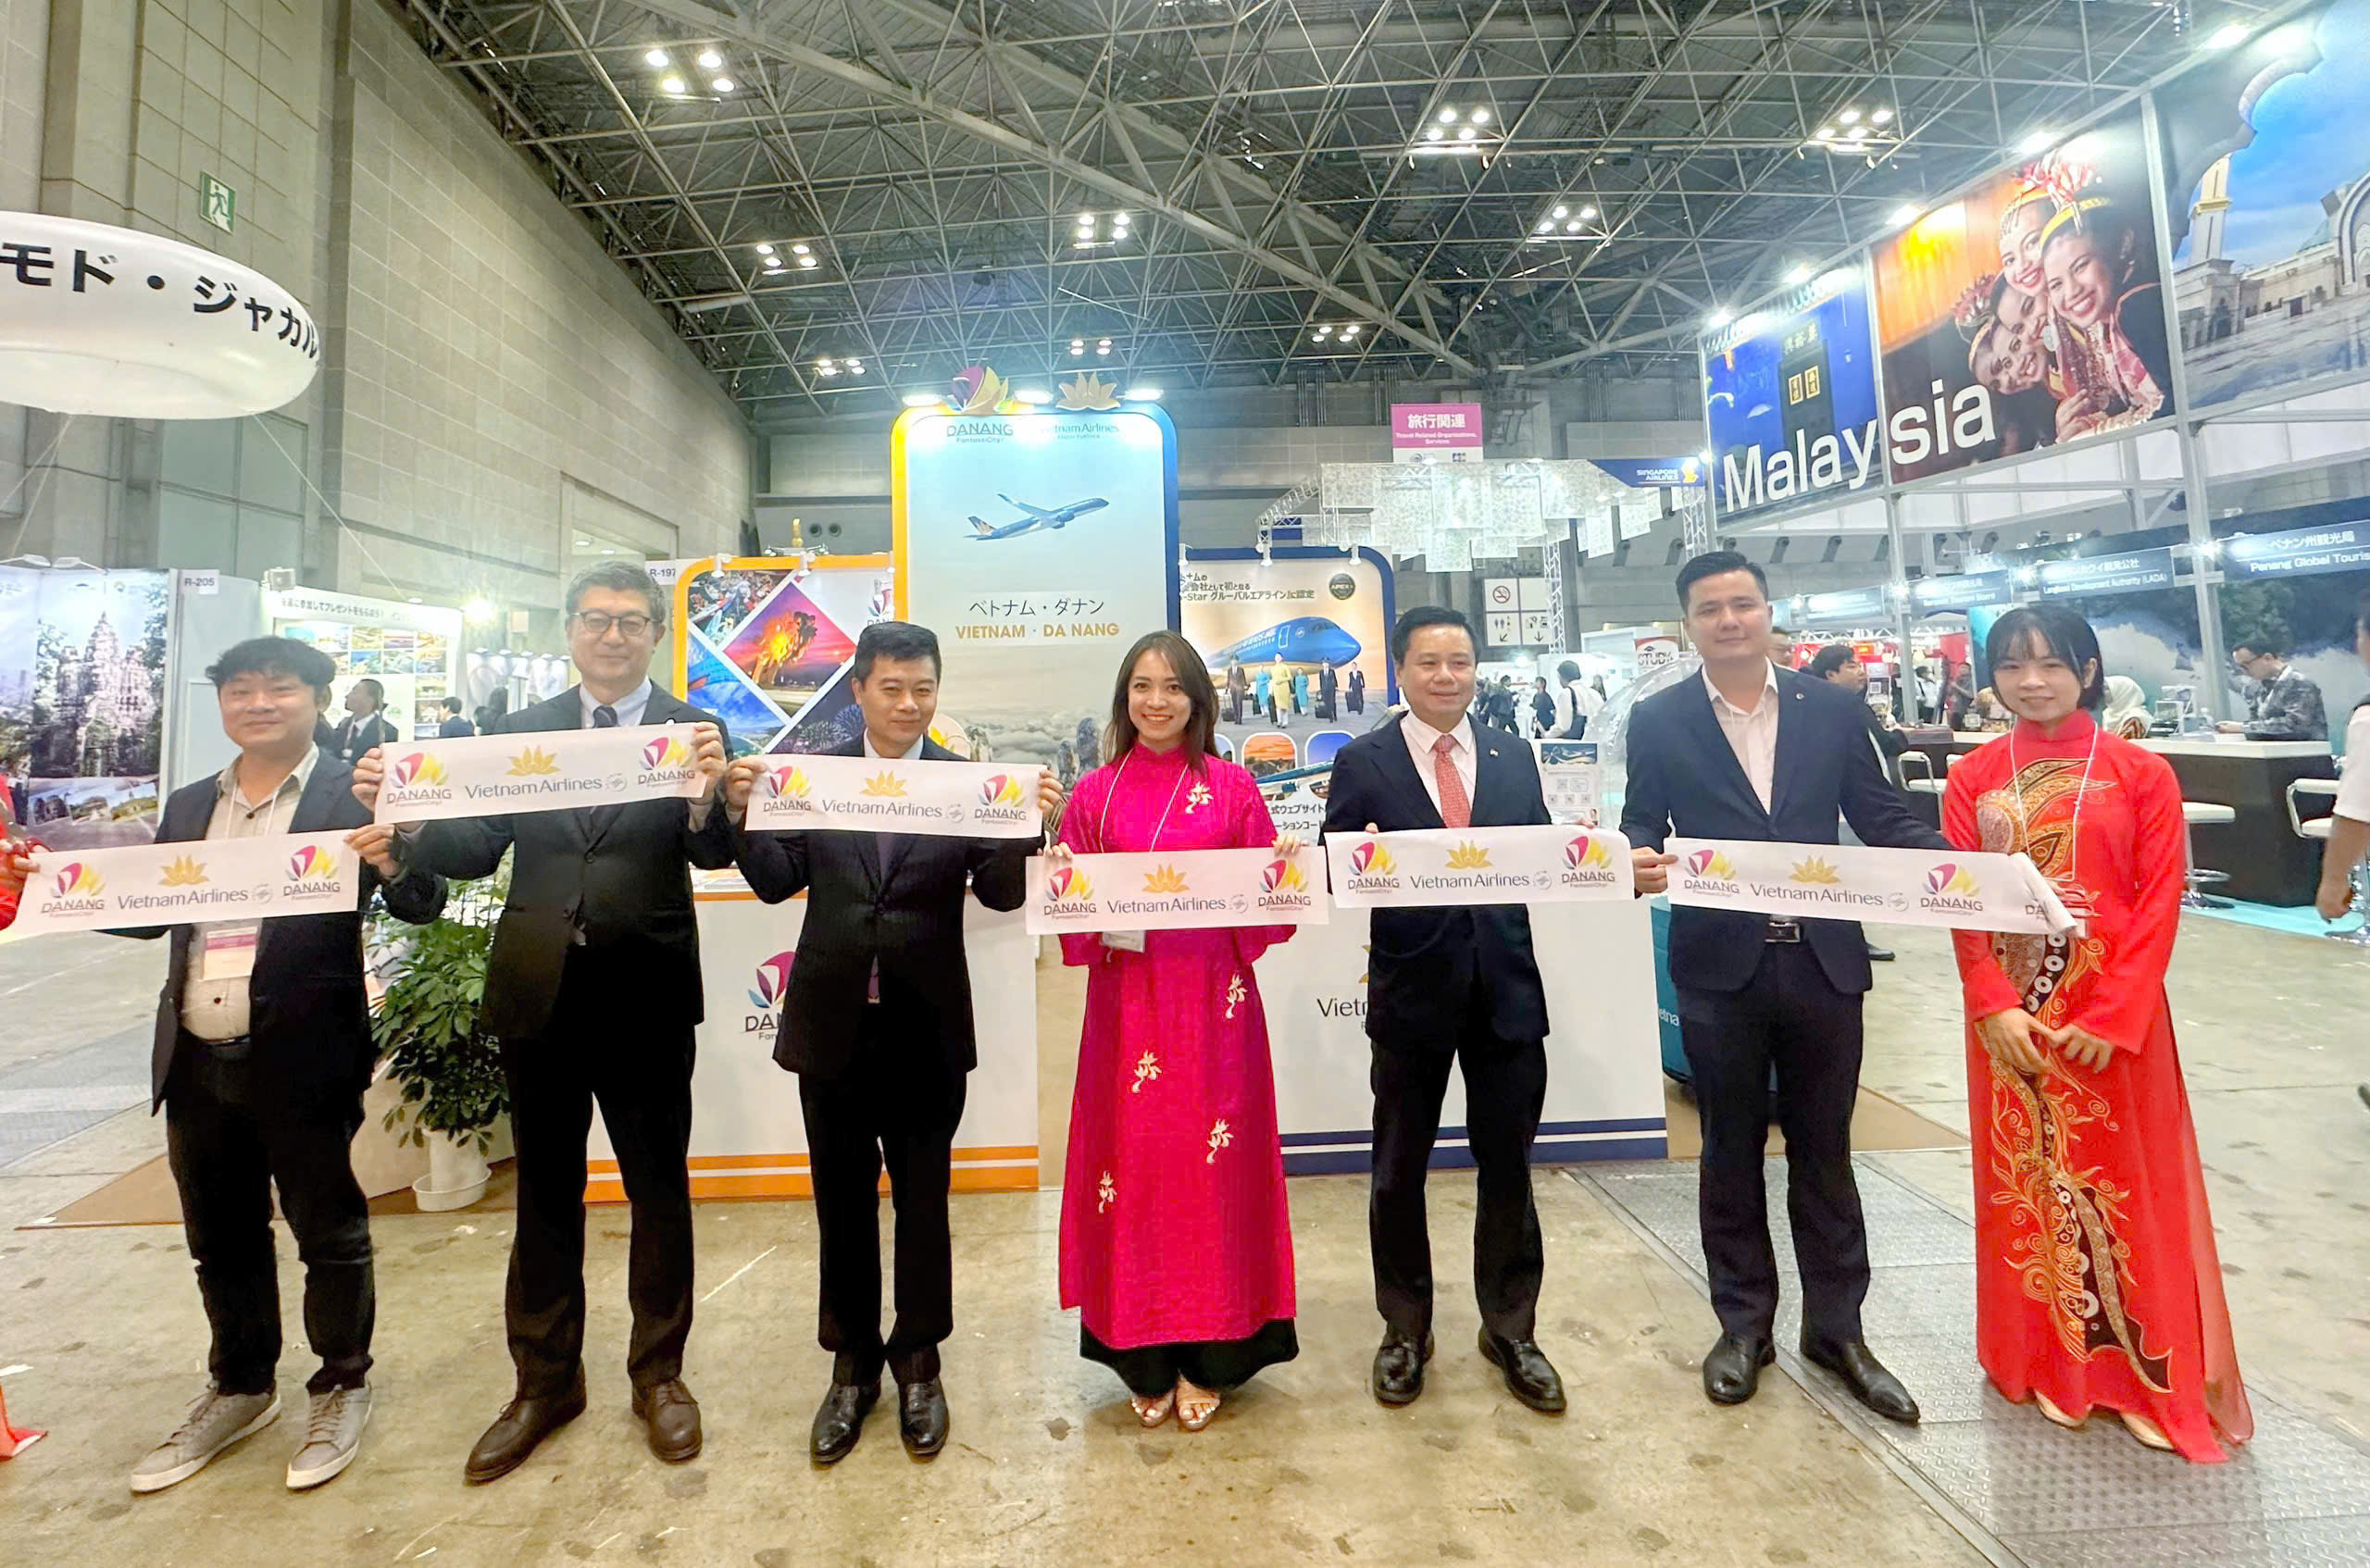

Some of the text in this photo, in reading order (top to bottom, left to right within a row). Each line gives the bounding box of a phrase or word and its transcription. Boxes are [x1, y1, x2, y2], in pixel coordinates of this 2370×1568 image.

[1408, 414, 1466, 429] 旅行関連
[946, 422, 1014, 437] DANANG
[1723, 379, 1996, 512] Malaysia
[2250, 561, 2292, 572] Penang
[2294, 555, 2329, 567] Global
[185, 578, 215, 586] R-205
[1180, 592, 1207, 601] -Star
[969, 597, 1104, 617] ベトナム・ダナン
[955, 623, 1119, 638] VIETNAM DA NANG
[637, 769, 695, 785] DANANG
[465, 778, 603, 799] Vietnam Airlines
[386, 789, 452, 804] DANANG
[763, 800, 812, 812] DANANG
[822, 800, 942, 817] Vietnam Airlines
[1270, 803, 1326, 815] 式ウェブサイト
[975, 808, 1027, 821] DANANG
[1348, 877, 1400, 889] DANANG
[1410, 873, 1529, 889] Vietnam Airlines
[1562, 871, 1615, 883] DANANG
[282, 881, 341, 896] DANANG
[1684, 880, 1740, 894] DANANG
[1750, 883, 1818, 901] Vietnam
[1820, 889, 1883, 906] Airlines
[118, 888, 249, 909] Vietnam Airlines
[1107, 897, 1226, 914] Vietnam Airlines
[1258, 894, 1311, 907] DANANG
[1920, 897, 1983, 912] DANANG
[41, 899, 105, 914] DANANG
[1044, 902, 1096, 915] DANANG
[744, 1013, 780, 1032] DA
